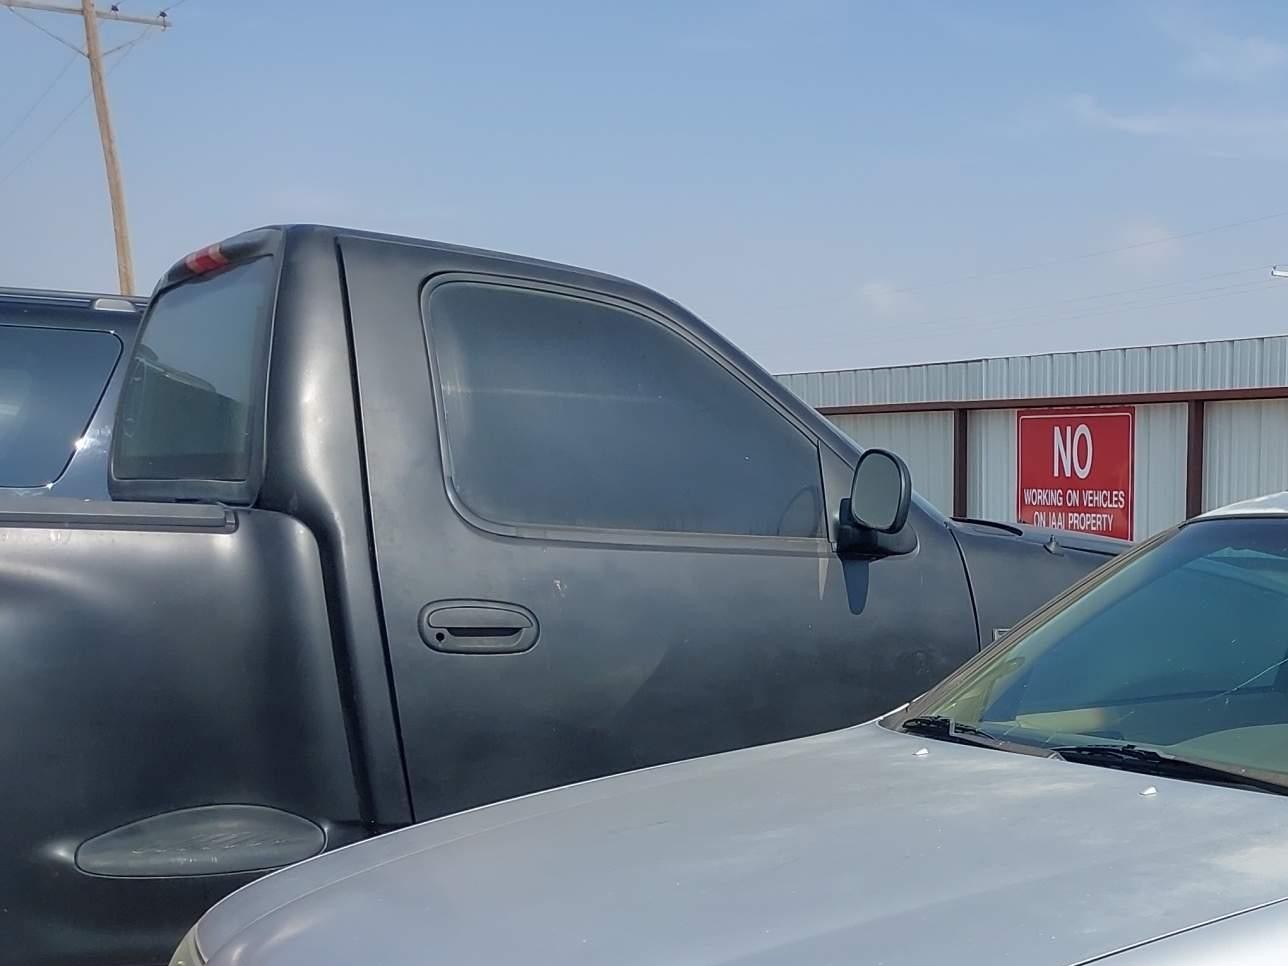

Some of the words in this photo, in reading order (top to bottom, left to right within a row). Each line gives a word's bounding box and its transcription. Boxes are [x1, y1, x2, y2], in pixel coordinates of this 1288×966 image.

[1053, 423, 1093, 479] NO
[1023, 488, 1063, 507] WORKING
[1066, 489, 1079, 507] ON
[1082, 490, 1125, 508] VEHICLES
[1033, 511, 1046, 528] ON
[1068, 512, 1114, 531] PROPERTY
